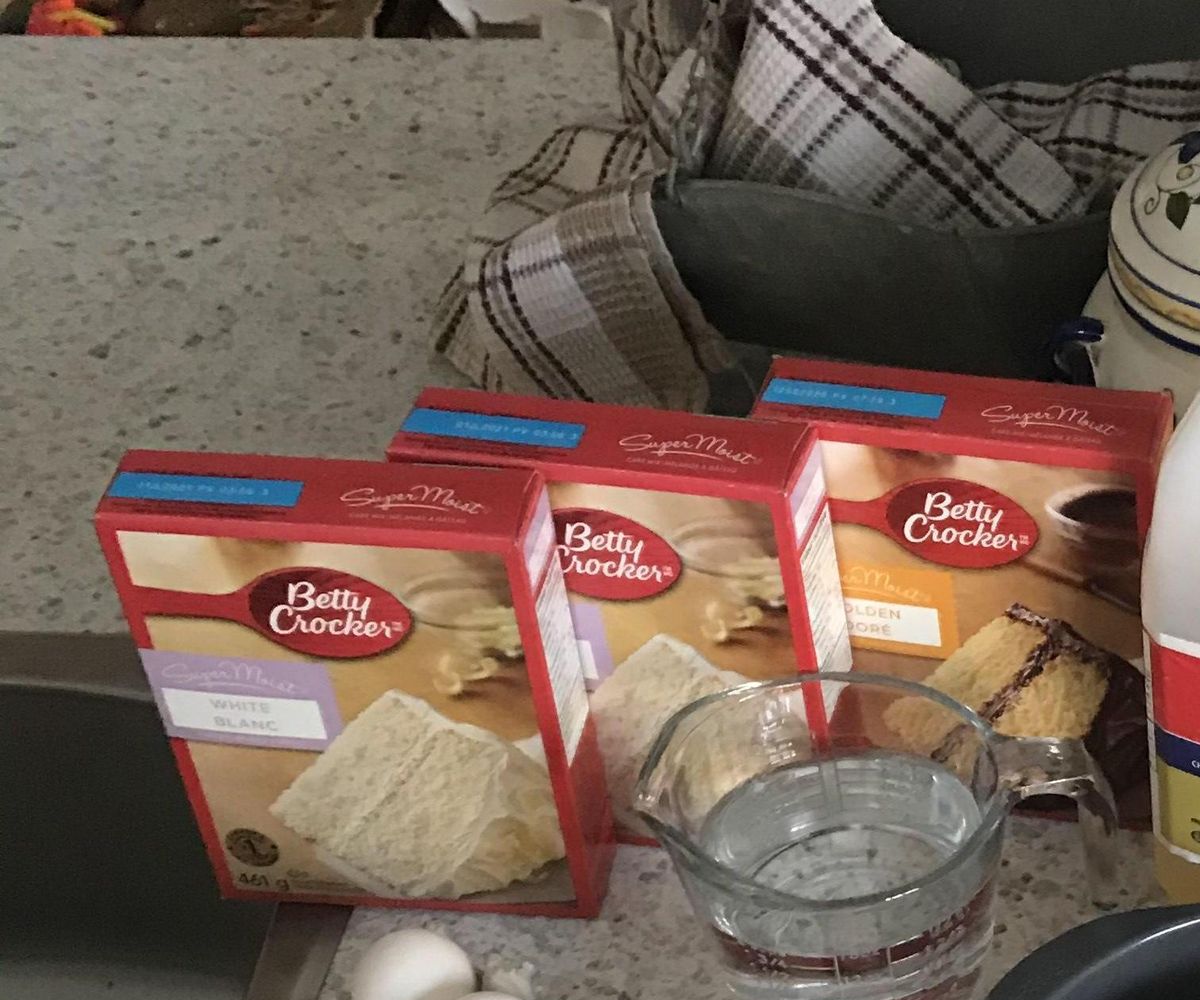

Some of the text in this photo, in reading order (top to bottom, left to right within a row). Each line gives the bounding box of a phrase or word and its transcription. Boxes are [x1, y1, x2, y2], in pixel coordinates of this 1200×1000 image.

[924, 491, 1003, 532] Betty
[565, 522, 644, 564] Betty
[903, 513, 1018, 551] Crocker
[287, 581, 371, 621] Betty
[844, 602, 901, 620] OLDEN
[269, 604, 393, 639] Crocker
[209, 698, 272, 714] WHITE
[213, 715, 280, 732] BLANC
